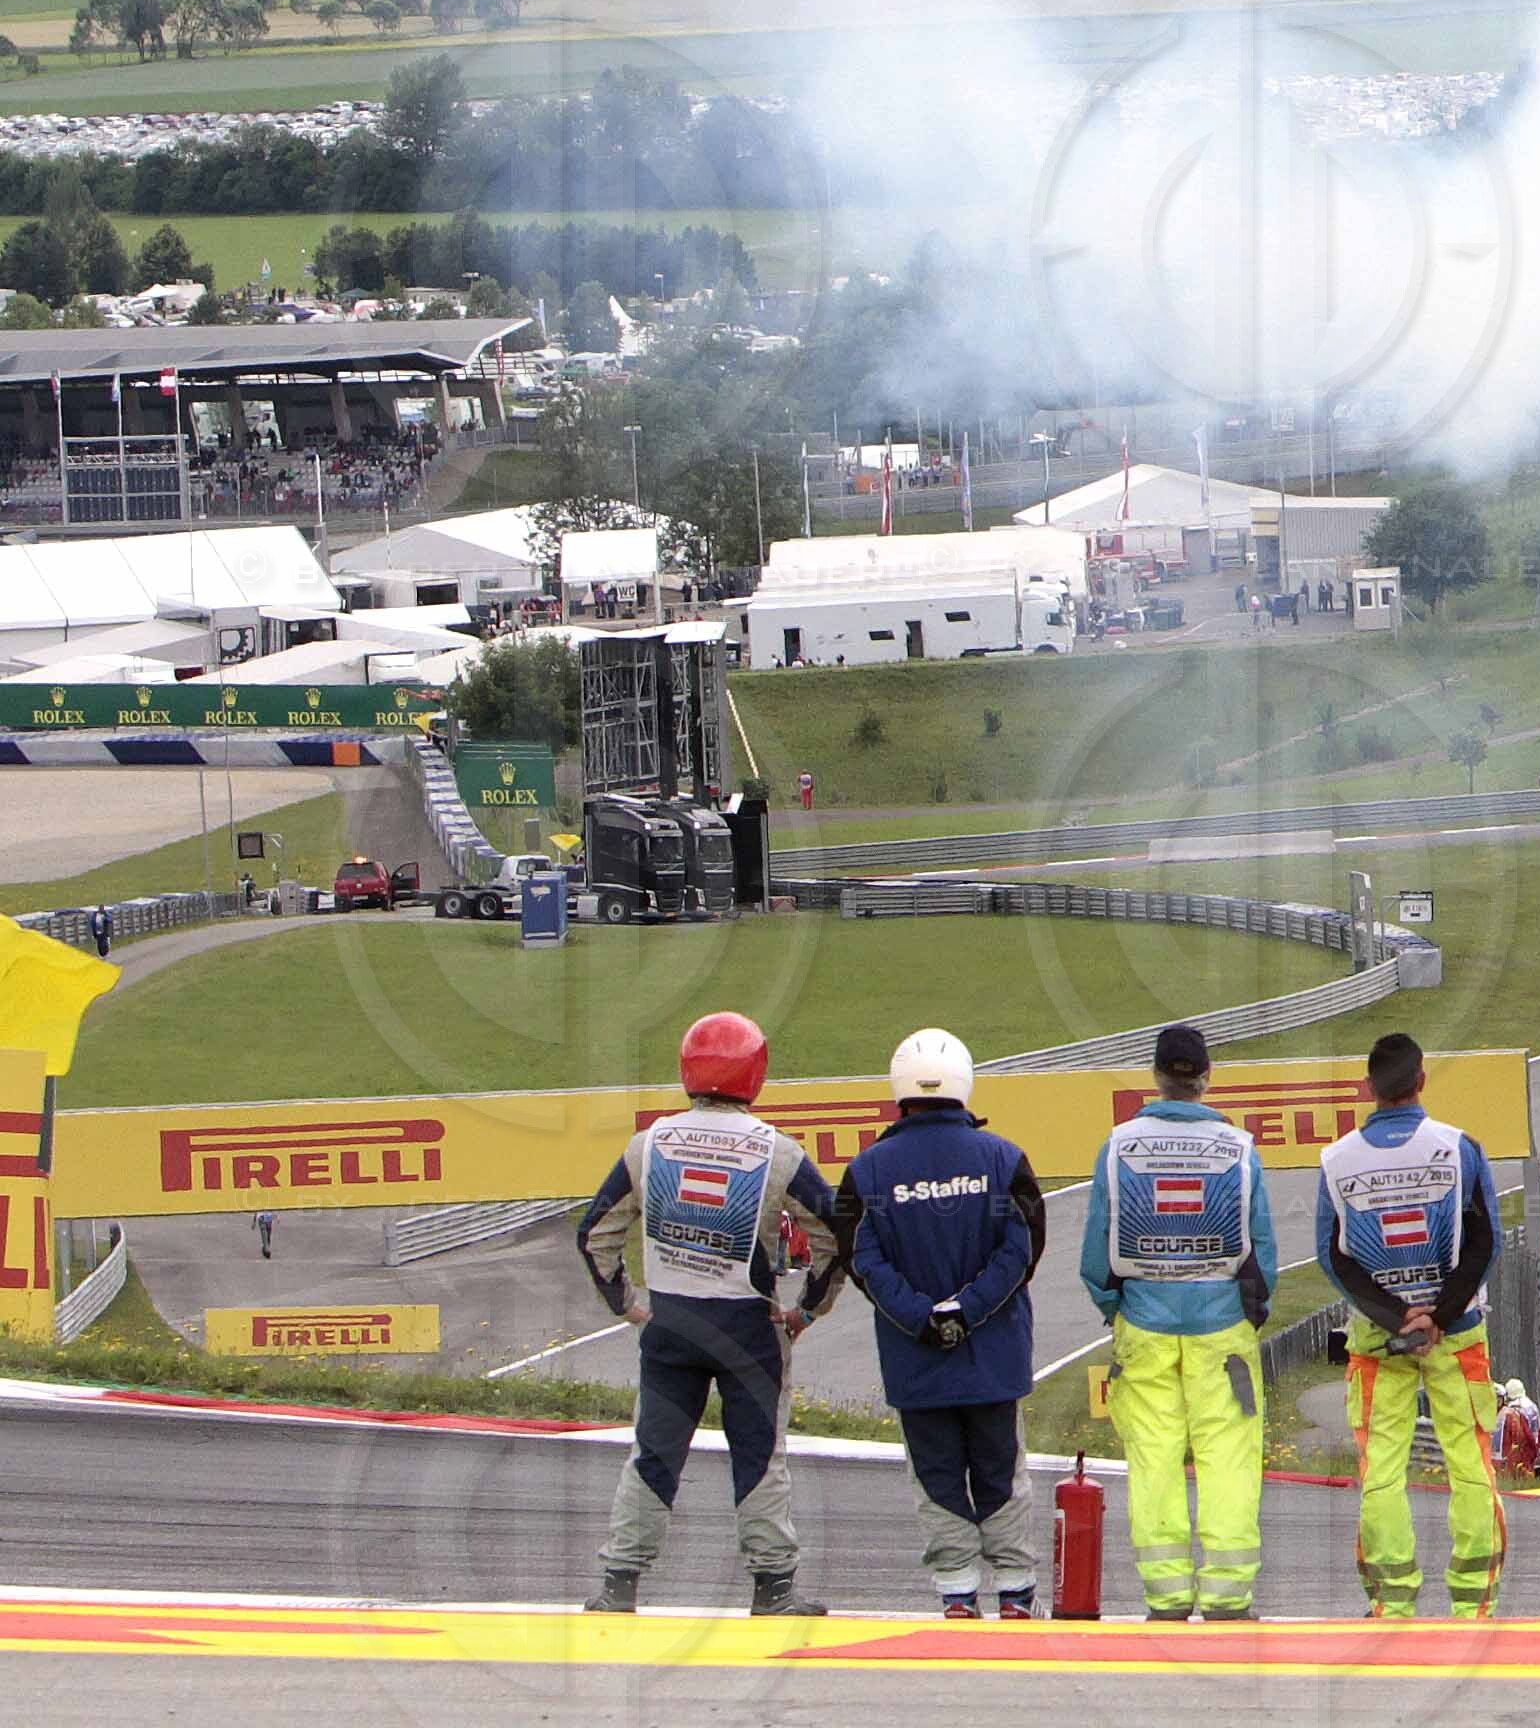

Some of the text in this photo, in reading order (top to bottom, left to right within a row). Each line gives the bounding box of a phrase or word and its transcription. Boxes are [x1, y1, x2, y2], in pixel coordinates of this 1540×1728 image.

[618, 585, 635, 599] WC
[33, 710, 86, 723] ROLEX
[118, 710, 171, 724] ROLEX
[205, 711, 257, 725] ROLEX
[288, 712, 341, 726] ROLEX
[376, 712, 417, 725] ROLE
[481, 789, 538, 805] ROLEX
[746, 1140, 769, 1154] 2015
[1214, 1144, 1239, 1158] 2015
[160, 1118, 445, 1193] PIRELLI
[1430, 1170, 1453, 1181] 2015
[893, 1175, 988, 1203] S-Staffel
[661, 1223, 734, 1251] COURSE
[1139, 1237, 1222, 1253] COURSE
[252, 1313, 392, 1346] PIRELLI
